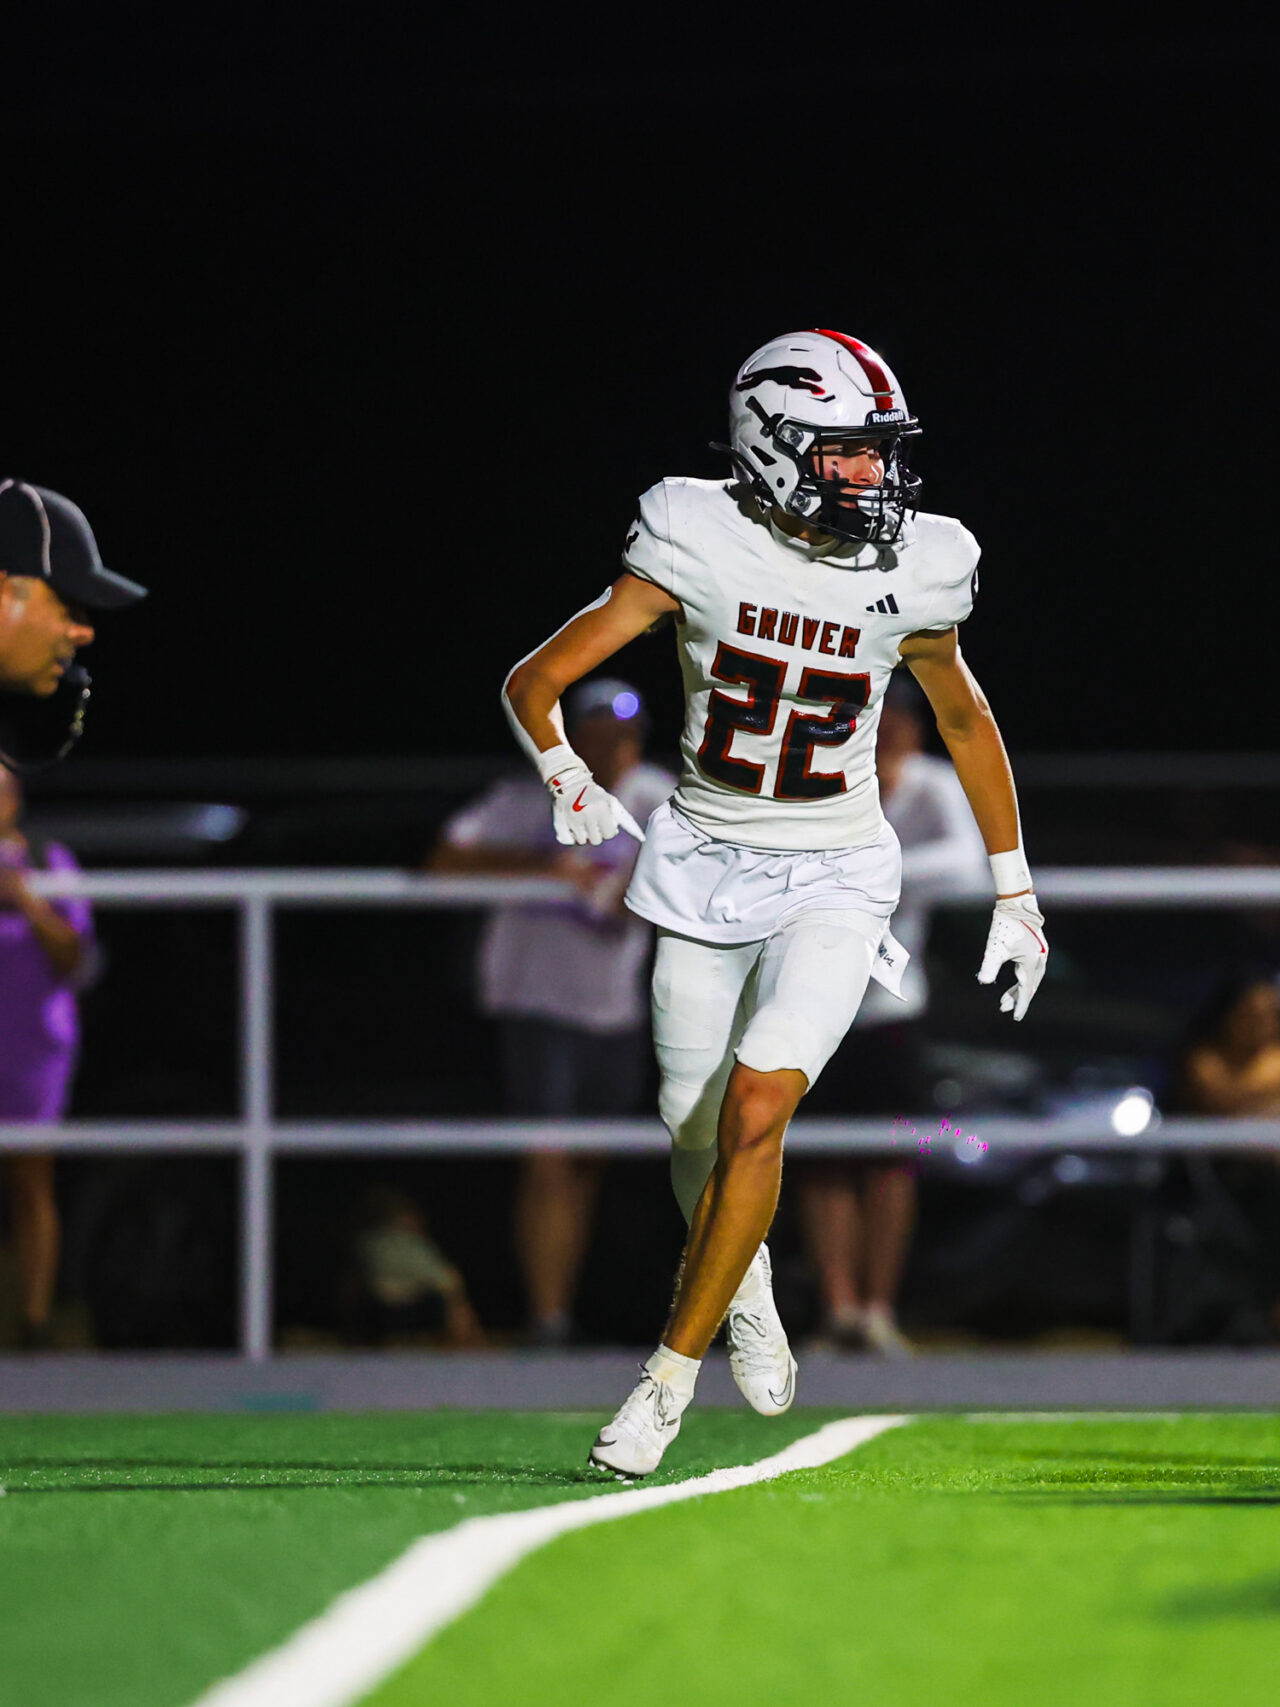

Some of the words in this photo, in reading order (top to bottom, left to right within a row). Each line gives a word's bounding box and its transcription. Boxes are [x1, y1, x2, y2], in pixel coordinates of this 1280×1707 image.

[872, 411, 905, 423] Riddell
[737, 602, 861, 658] GRUVER
[697, 639, 872, 798] 22
